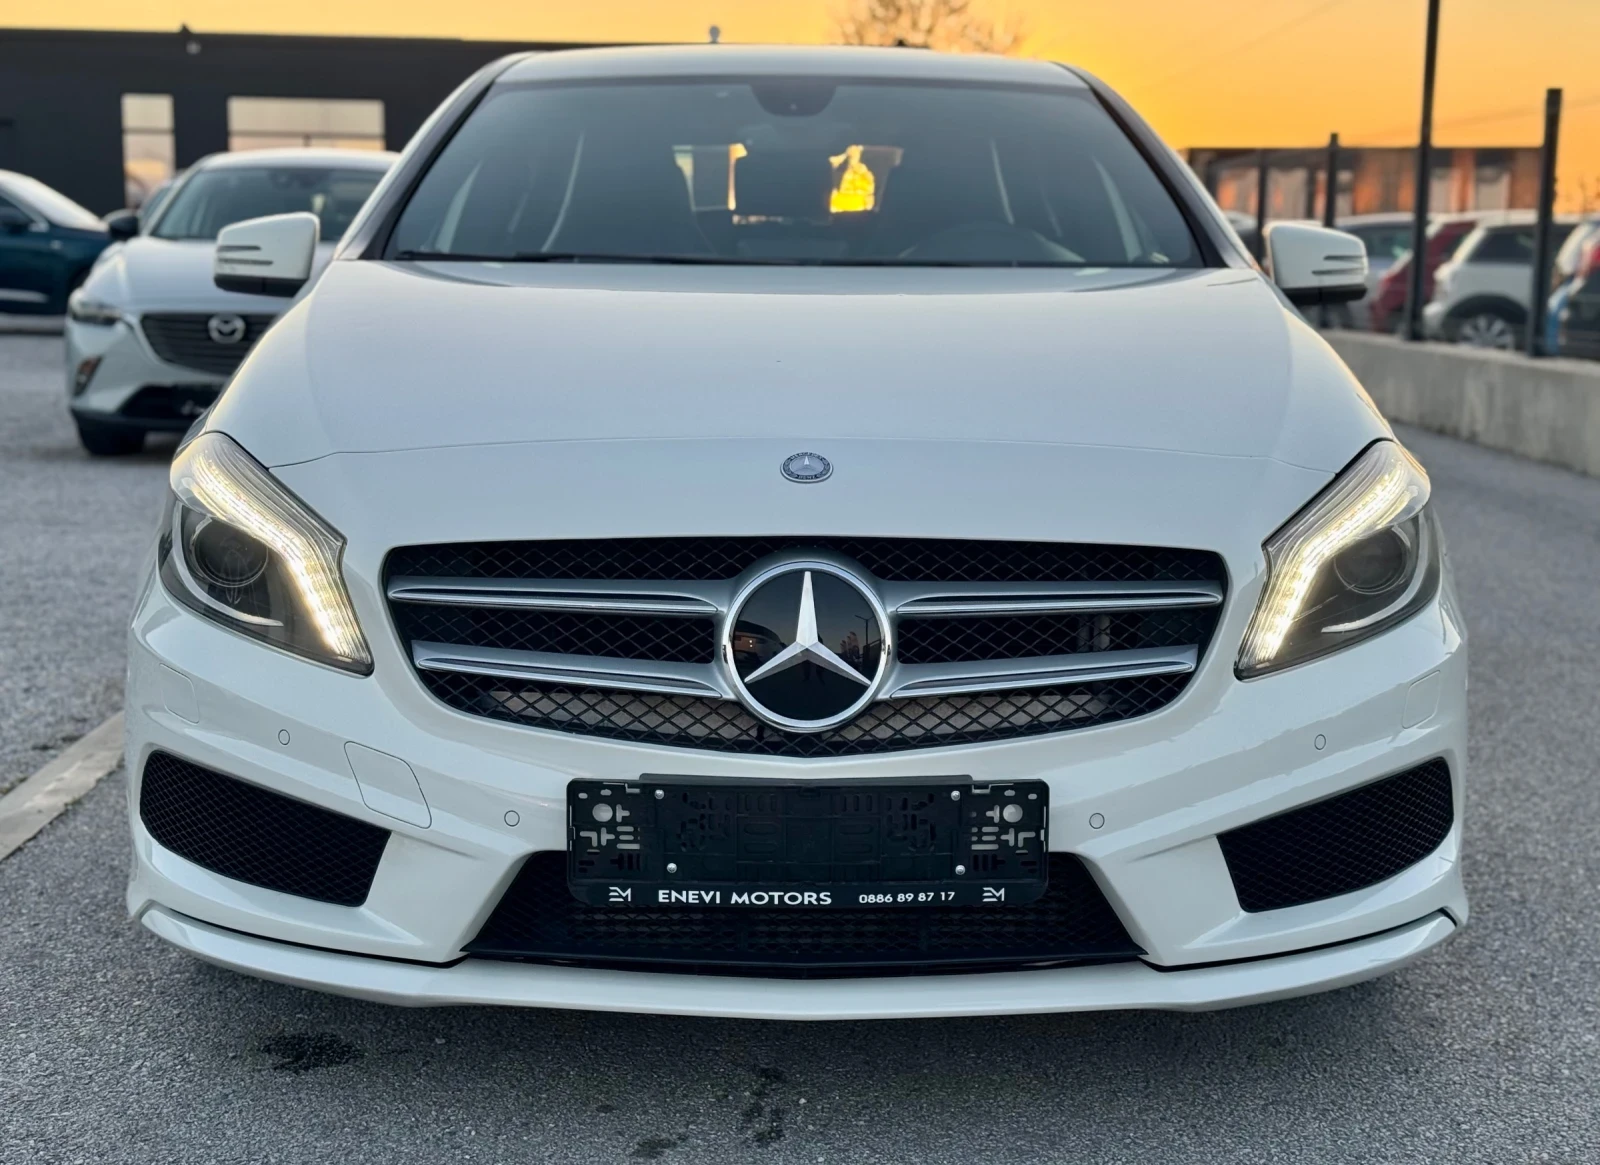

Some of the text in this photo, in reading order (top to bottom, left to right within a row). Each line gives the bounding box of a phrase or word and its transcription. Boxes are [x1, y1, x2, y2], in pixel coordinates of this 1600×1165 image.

[658, 889, 721, 904] ENEVI
[730, 891, 832, 906] MOTORS
[858, 893, 893, 904] 0886
[896, 893, 914, 903] 89
[917, 892, 935, 902] 87
[940, 891, 956, 901] 17
